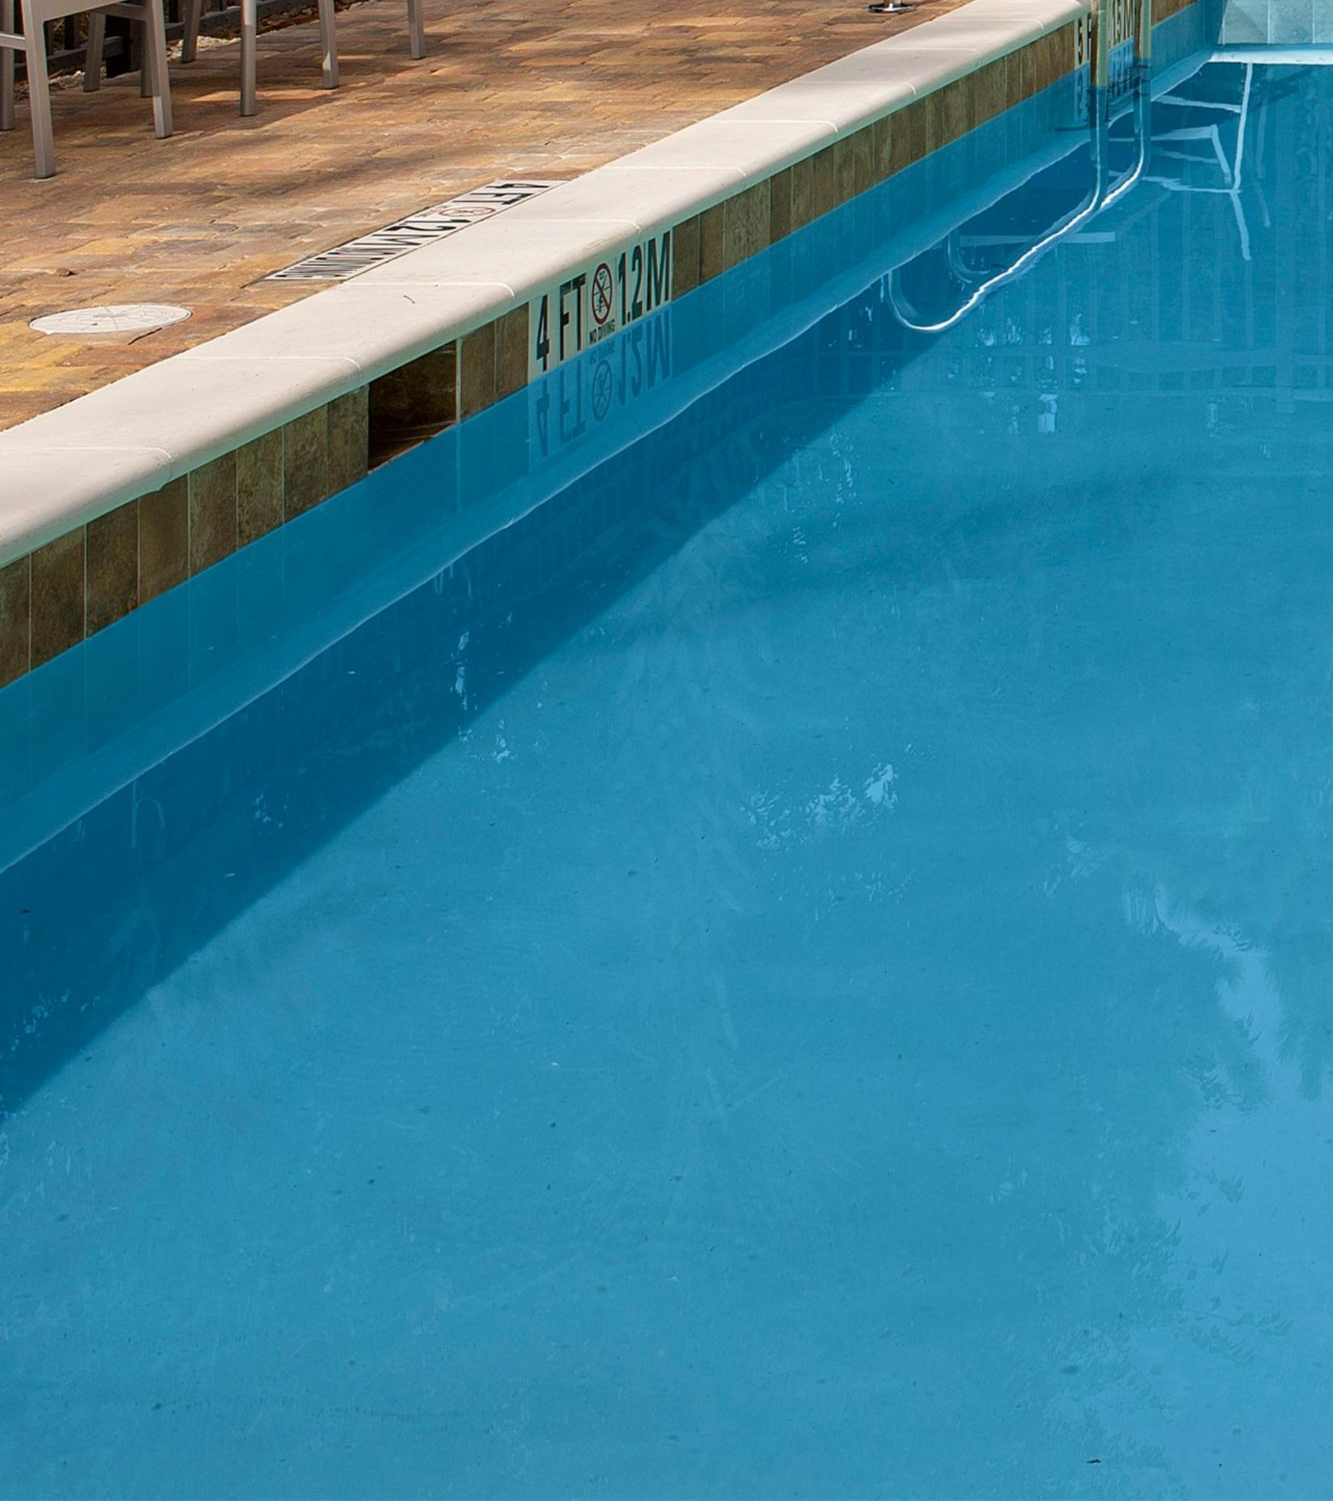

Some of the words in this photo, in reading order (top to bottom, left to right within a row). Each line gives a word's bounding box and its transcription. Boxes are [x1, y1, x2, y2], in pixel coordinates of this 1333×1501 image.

[452, 192, 535, 205] FT
[352, 233, 440, 247] M
[536, 294, 550, 372] 4
[559, 272, 587, 362] FT
[618, 244, 643, 326] 1.2
[646, 229, 671, 312] M
